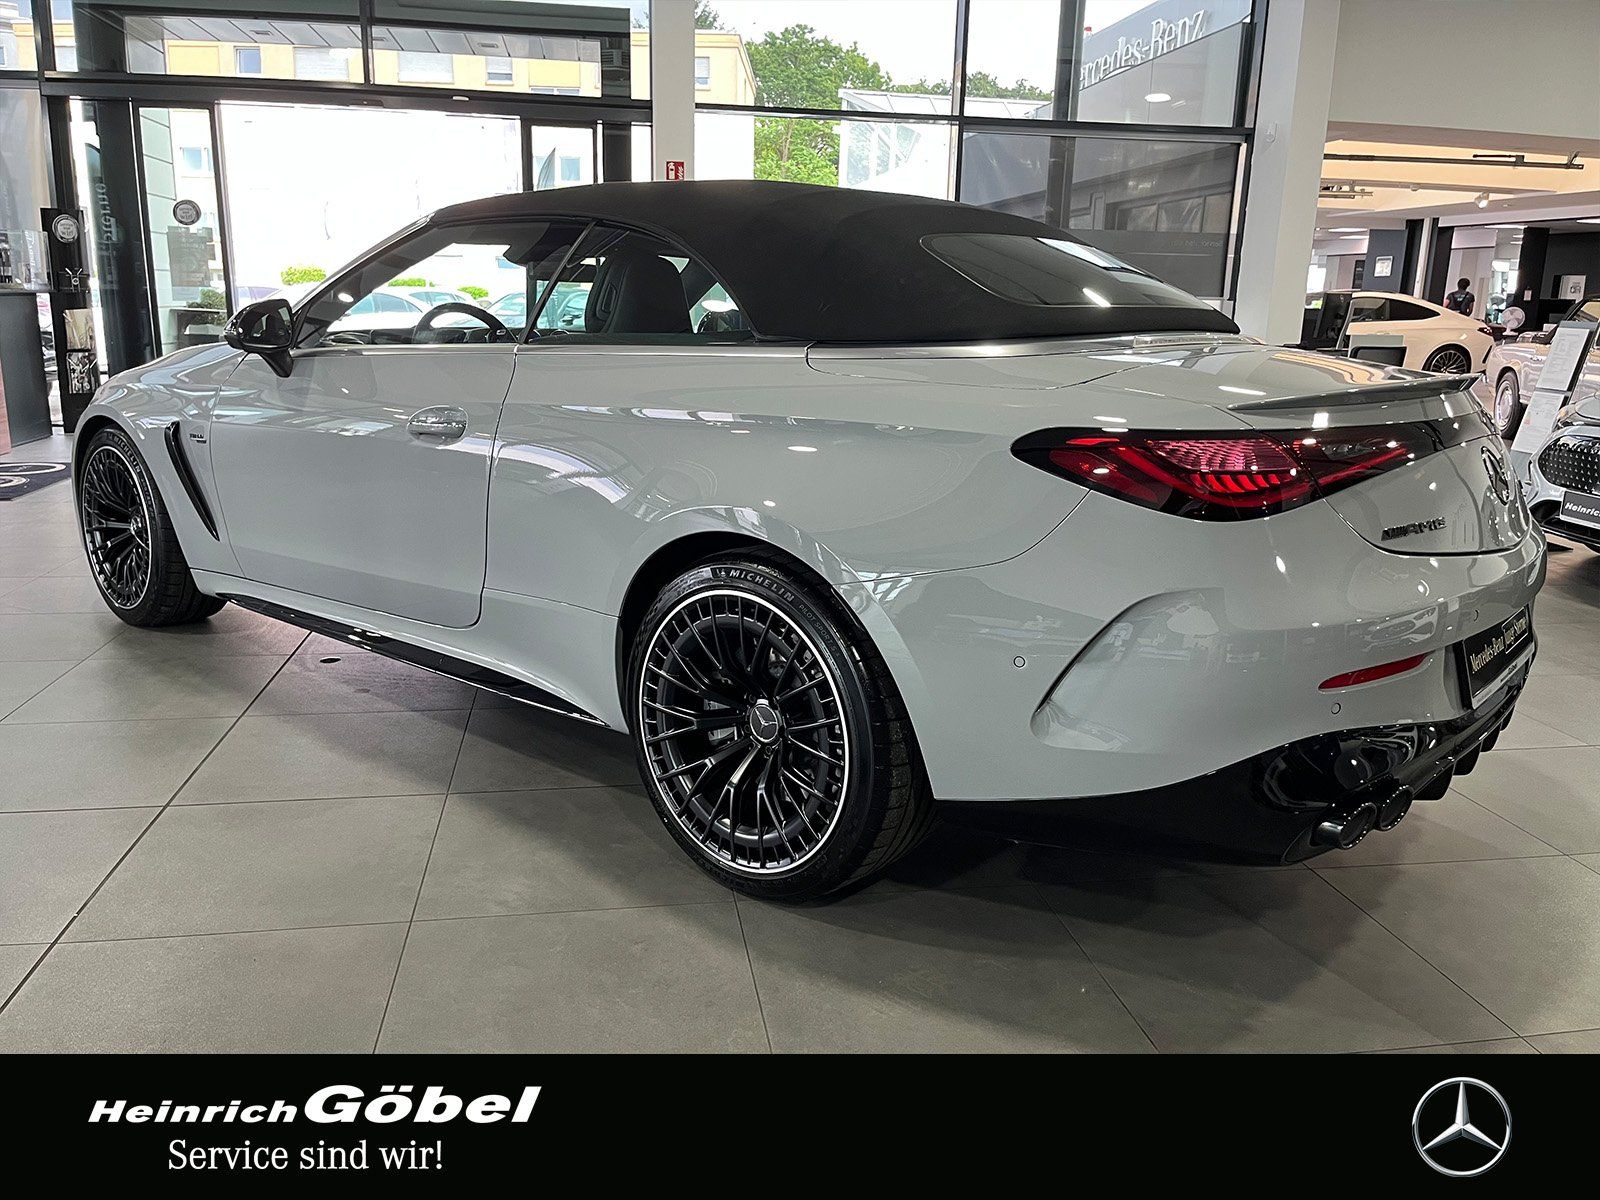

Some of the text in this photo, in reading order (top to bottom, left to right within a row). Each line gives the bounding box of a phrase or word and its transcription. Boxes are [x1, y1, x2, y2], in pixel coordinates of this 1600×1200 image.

[1079, 9, 1207, 91] ercedes-Benz
[729, 569, 796, 603] MICHELIN
[798, 603, 816, 622] PILOT
